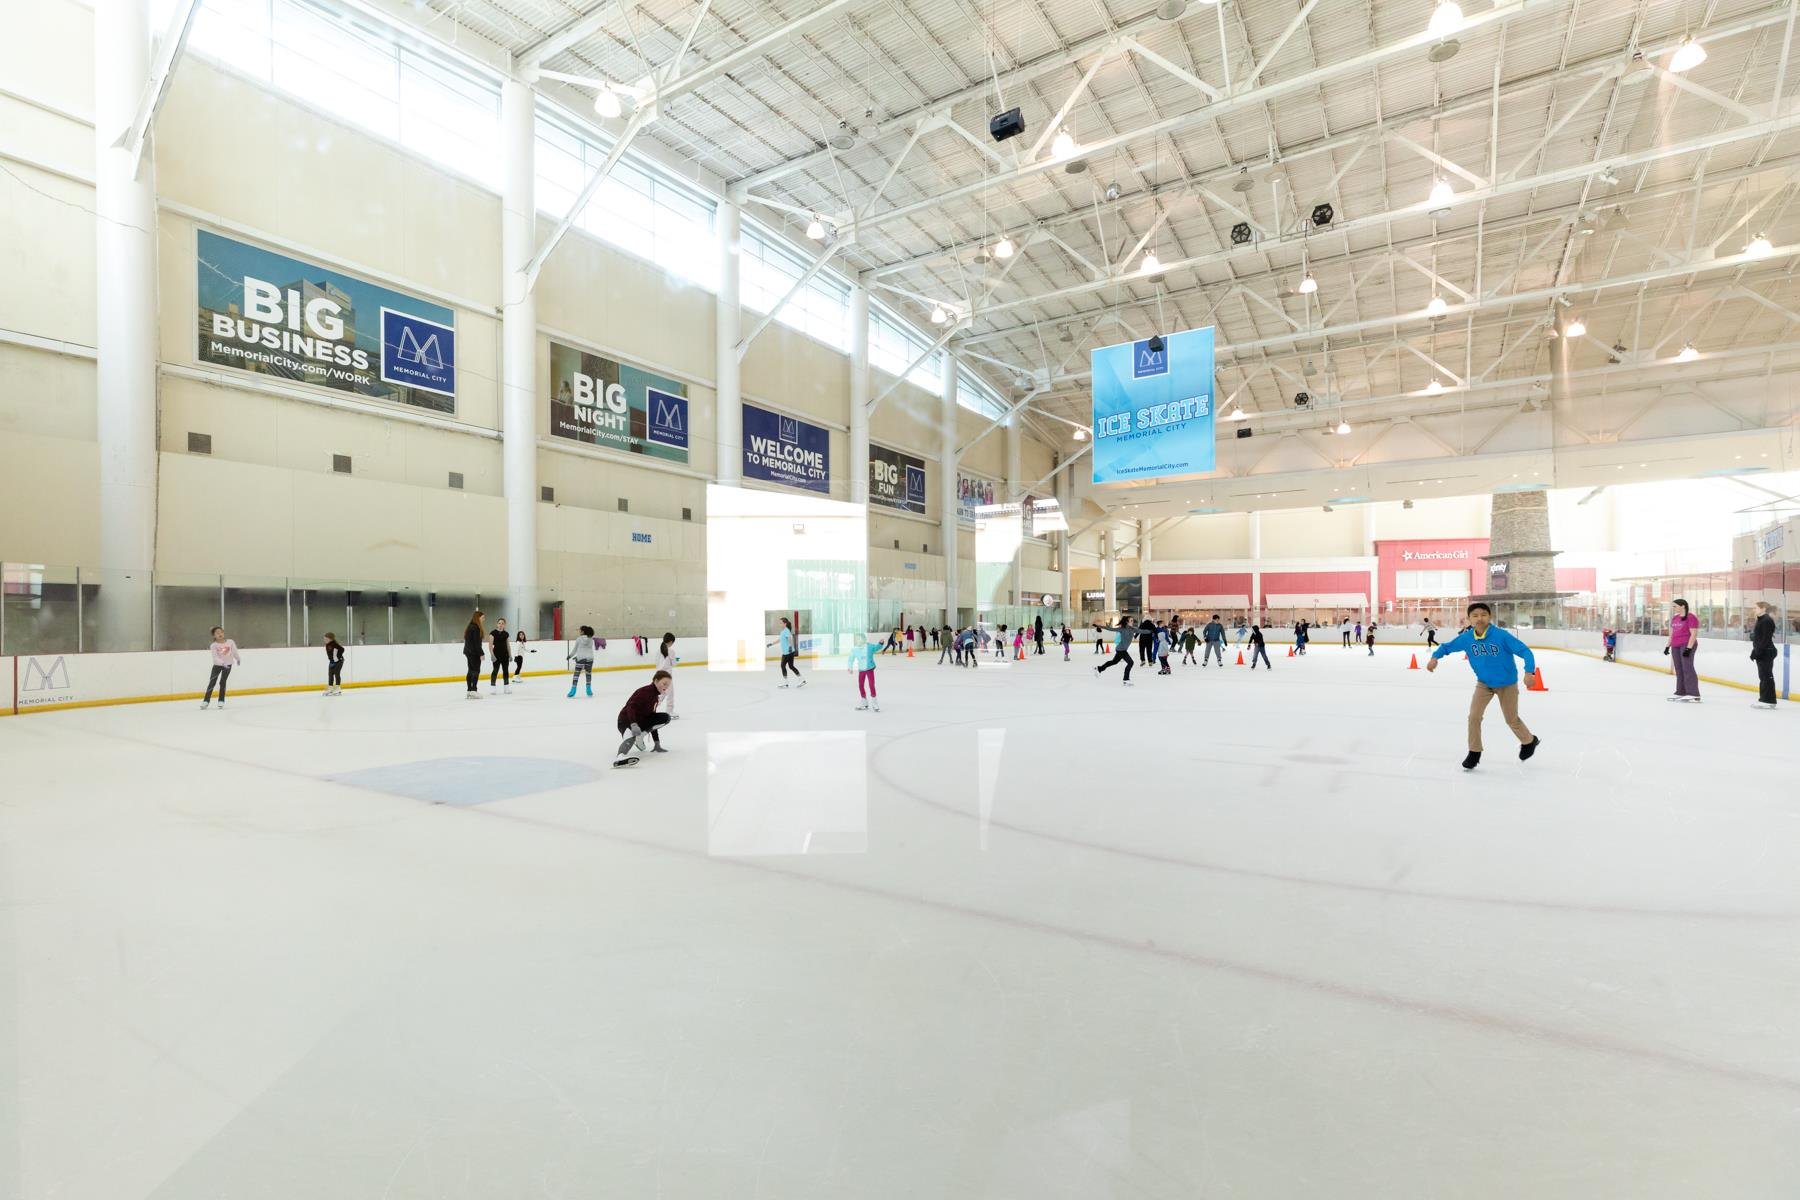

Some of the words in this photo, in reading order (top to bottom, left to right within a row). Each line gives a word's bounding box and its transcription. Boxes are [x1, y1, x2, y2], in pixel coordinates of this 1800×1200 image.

[243, 276, 344, 341] BIG
[212, 313, 369, 370] BUSINESS
[211, 340, 370, 386] MemorialCity.com/WORK
[393, 365, 430, 380] MEMORIAL
[431, 375, 447, 383] CITY
[573, 371, 627, 414] BIG
[574, 404, 627, 431] NIGHT
[1097, 411, 1131, 439] ICE
[1136, 394, 1209, 430] SKATE
[559, 420, 639, 445] MemorialCity.com/STAY
[1116, 429, 1163, 443] MEMORIAL
[1166, 422, 1187, 432] CITY
[750, 434, 823, 470] WELCOME
[746, 452, 760, 465] TO
[762, 456, 807, 476] MEMORIAL
[808, 467, 826, 480] CITY
[874, 459, 898, 485] BIG
[878, 482, 894, 496] FUN
[631, 532, 652, 543] HOME
[1414, 551, 1453, 560] American
[1453, 550, 1469, 560] Girl
[1471, 643, 1499, 657] GAP
[18, 697, 55, 705] MEMORIAL
